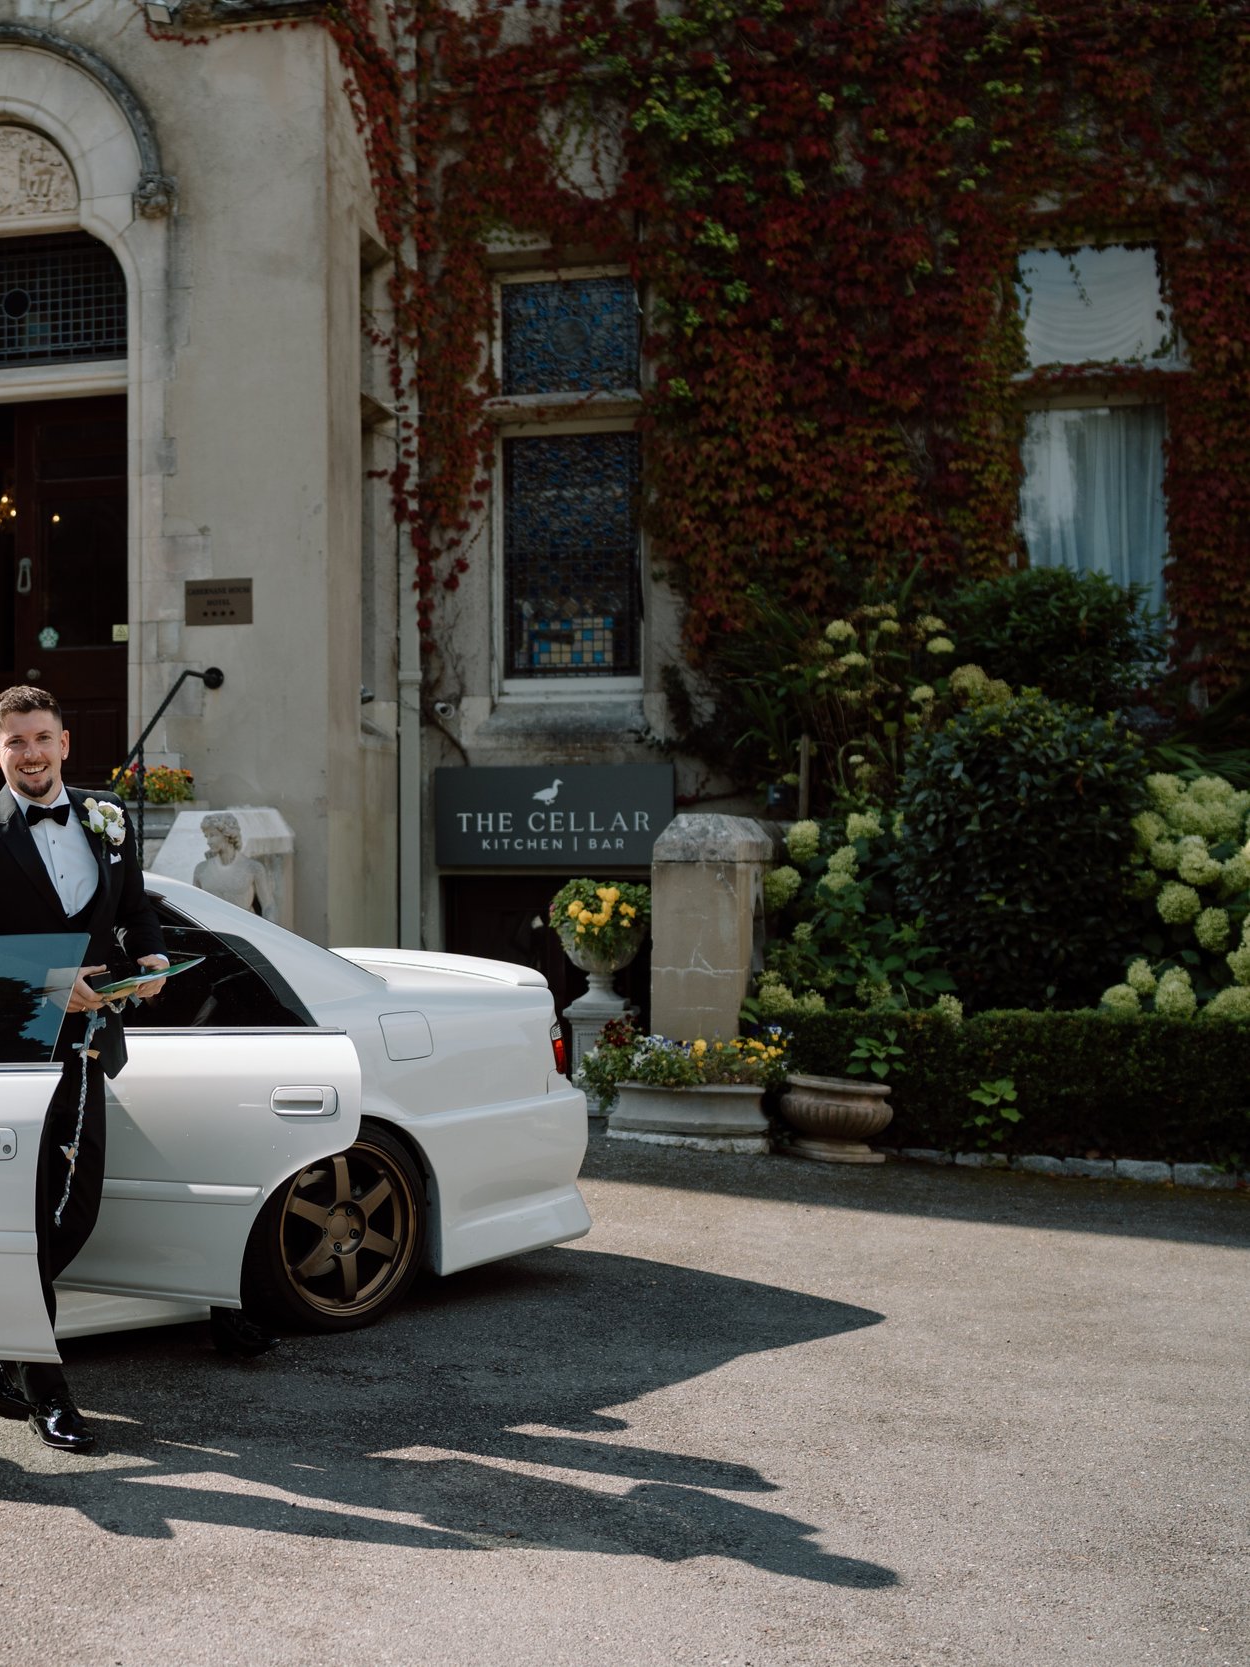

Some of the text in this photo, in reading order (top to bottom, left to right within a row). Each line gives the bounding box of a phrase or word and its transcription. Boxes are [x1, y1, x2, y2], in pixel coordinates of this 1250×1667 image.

[456, 811, 651, 833] THE CELLAR
[482, 838, 563, 850] KITCHEN
[588, 838, 625, 850] BAR
